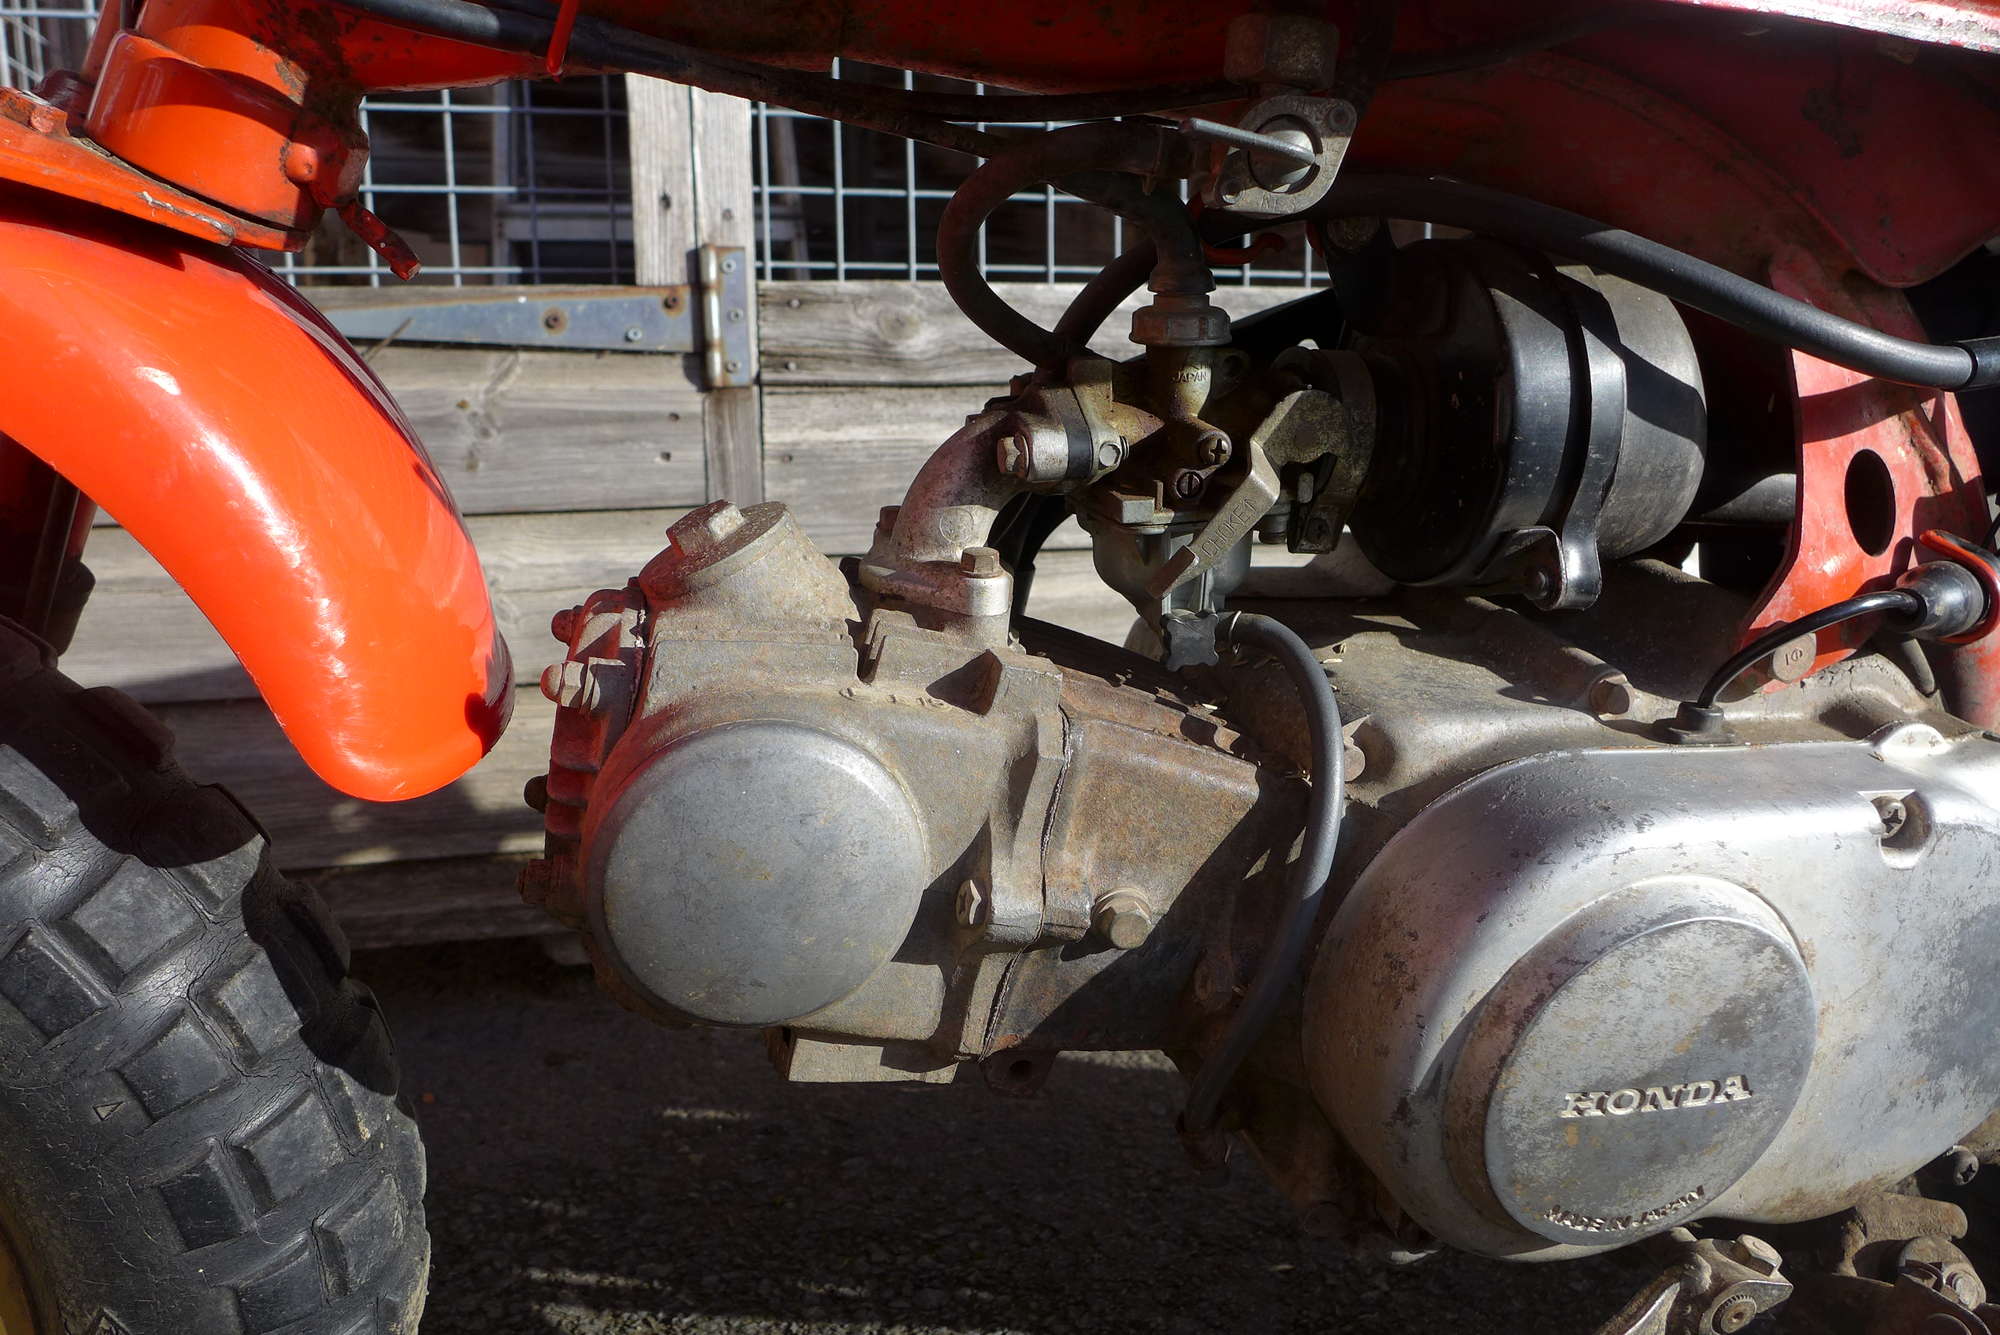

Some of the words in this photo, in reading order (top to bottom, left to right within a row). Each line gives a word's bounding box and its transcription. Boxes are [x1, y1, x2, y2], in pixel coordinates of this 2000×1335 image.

[1171, 371, 1208, 384] JAPAN
[1201, 503, 1250, 559] CHOKE
[1559, 1074, 1752, 1118] HONDA
[1544, 1205, 1605, 1233] MADE
[1606, 1215, 1632, 1232] IN
[1633, 1185, 1704, 1226] JAPAN
